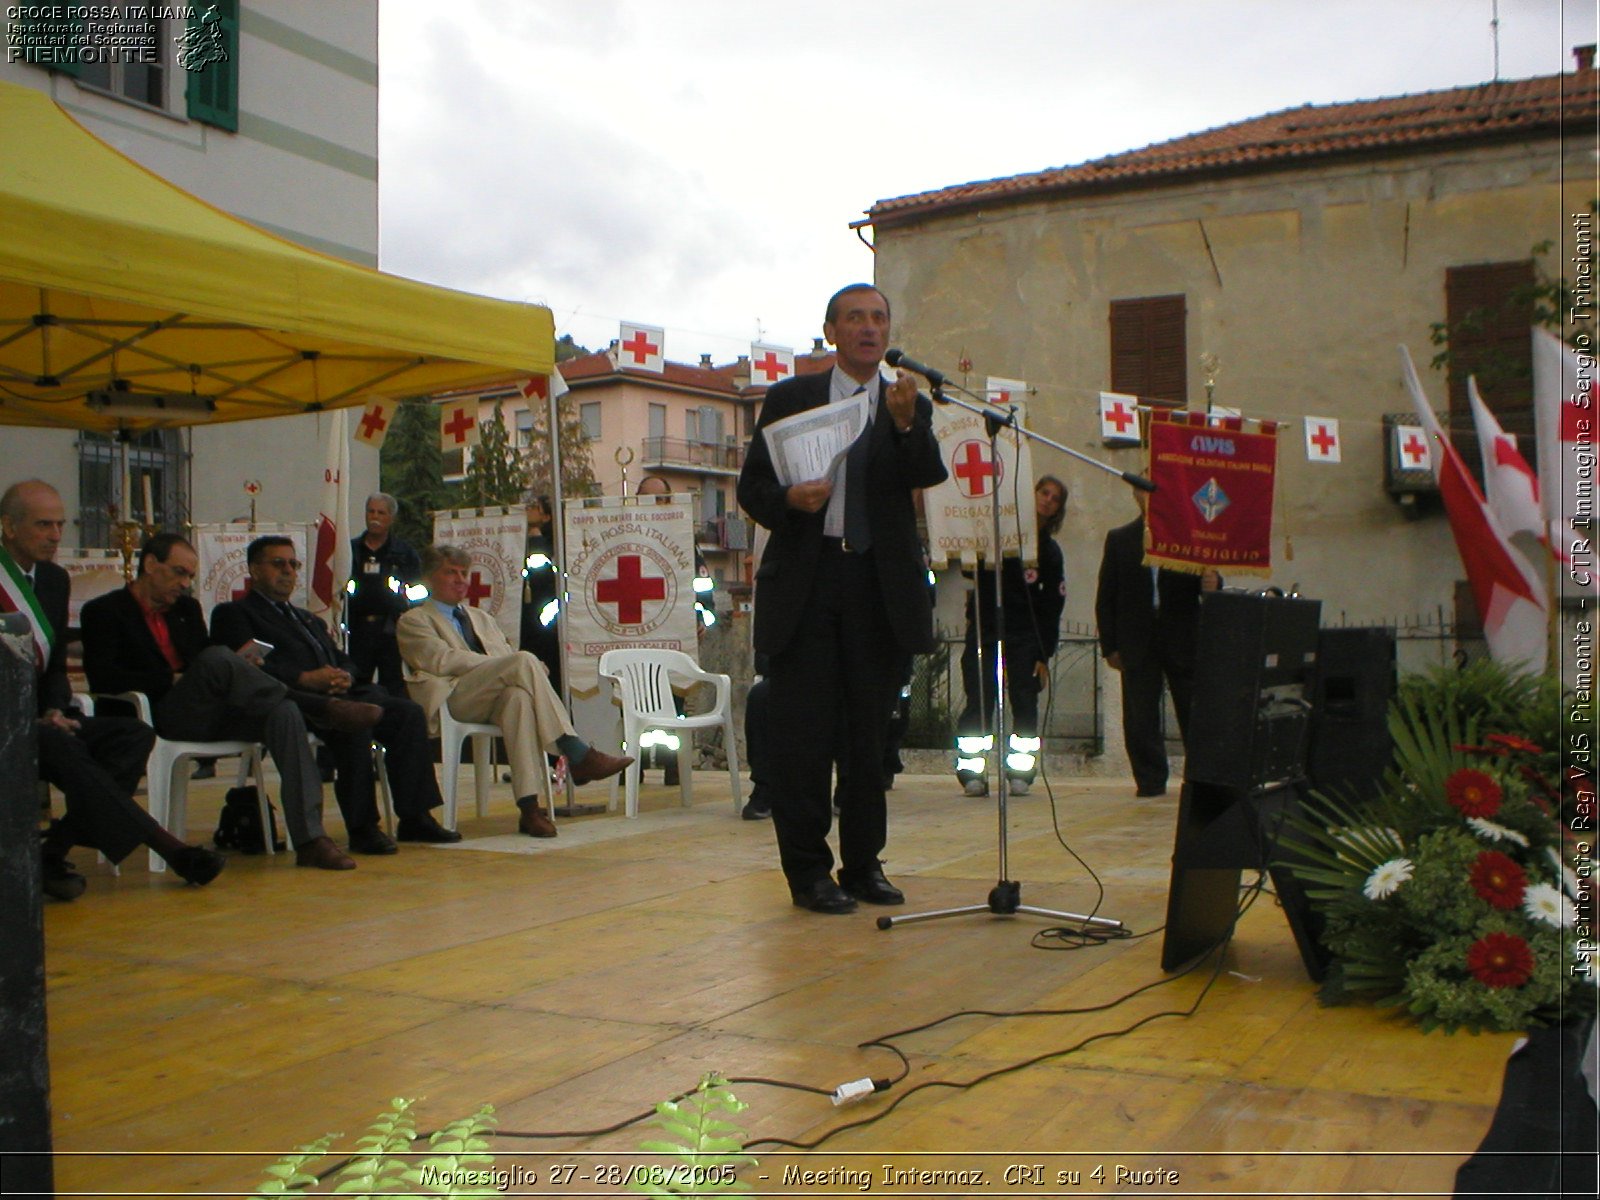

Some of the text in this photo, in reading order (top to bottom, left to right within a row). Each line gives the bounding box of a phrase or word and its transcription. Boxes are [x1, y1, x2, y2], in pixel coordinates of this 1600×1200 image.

[1190, 435, 1236, 456] AVIS
[597, 513, 632, 523] VOLONTARI
[635, 513, 648, 522] DEL
[570, 523, 690, 576] CROCE ROSSA ITALIANA
[1157, 542, 1260, 560] MONESIGLIO
